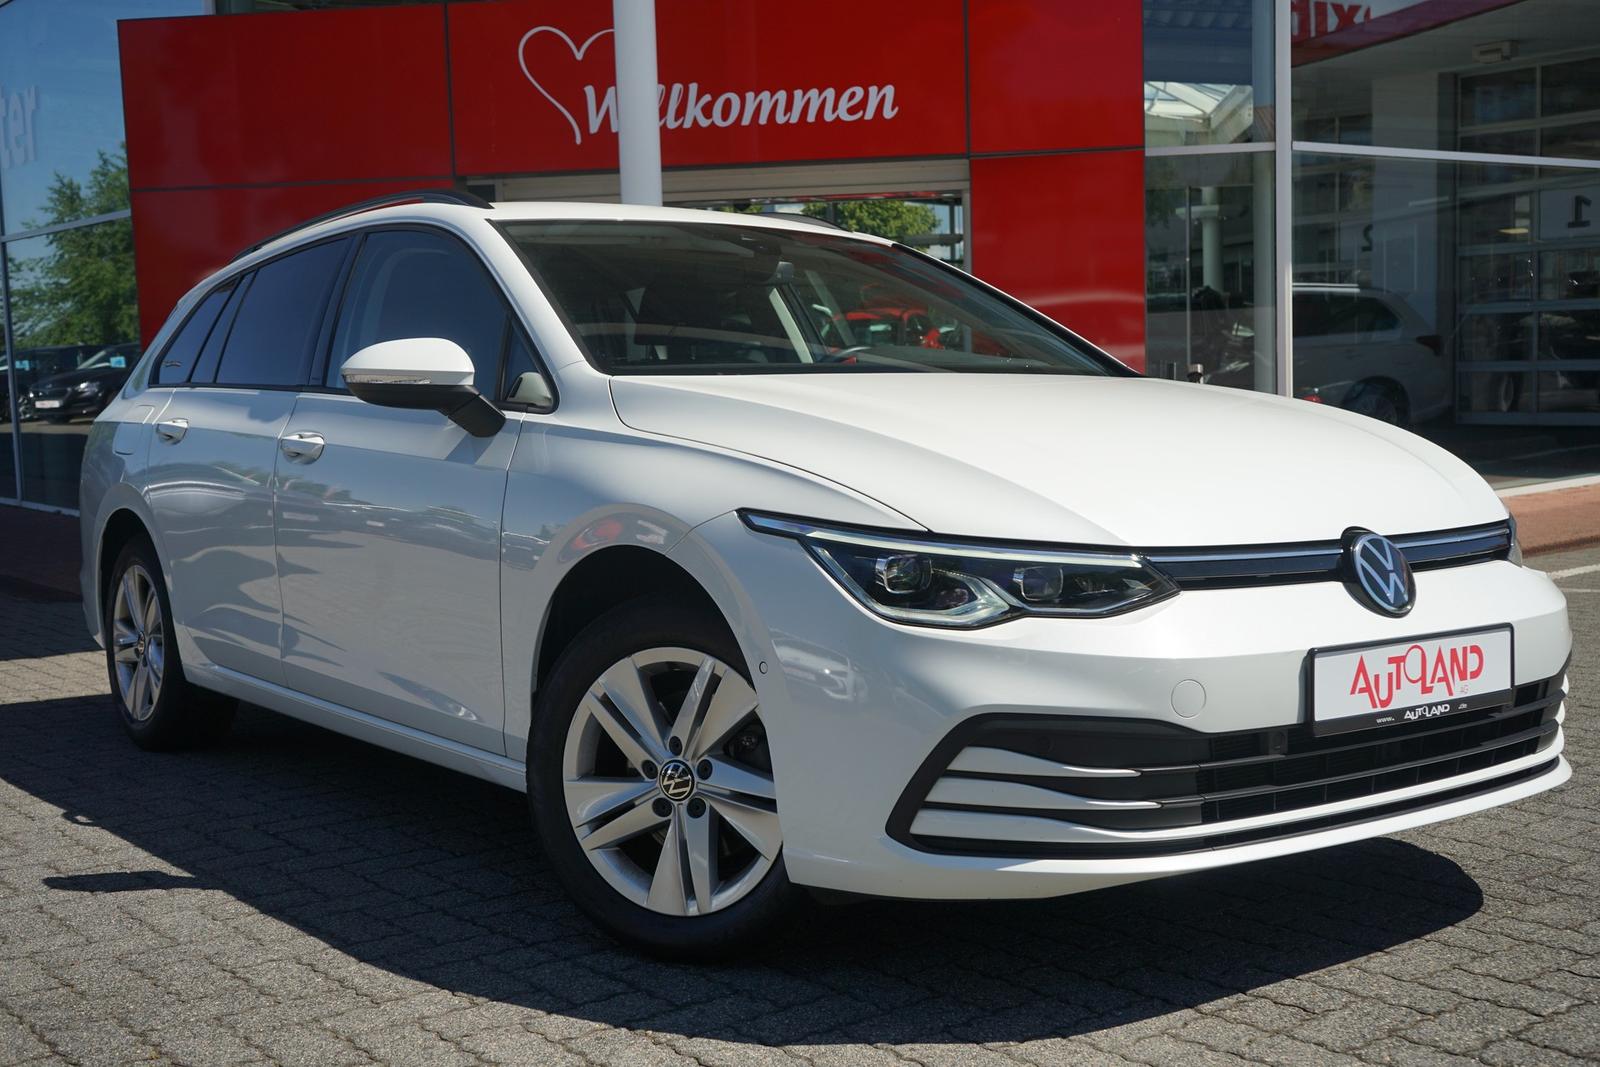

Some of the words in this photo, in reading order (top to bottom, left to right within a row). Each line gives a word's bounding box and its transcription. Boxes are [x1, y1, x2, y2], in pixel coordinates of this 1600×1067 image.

[583, 82, 899, 135] Wlkommen
[1350, 644, 1484, 709] AUTOLAND
[1404, 703, 1450, 721] AUTOLAND
